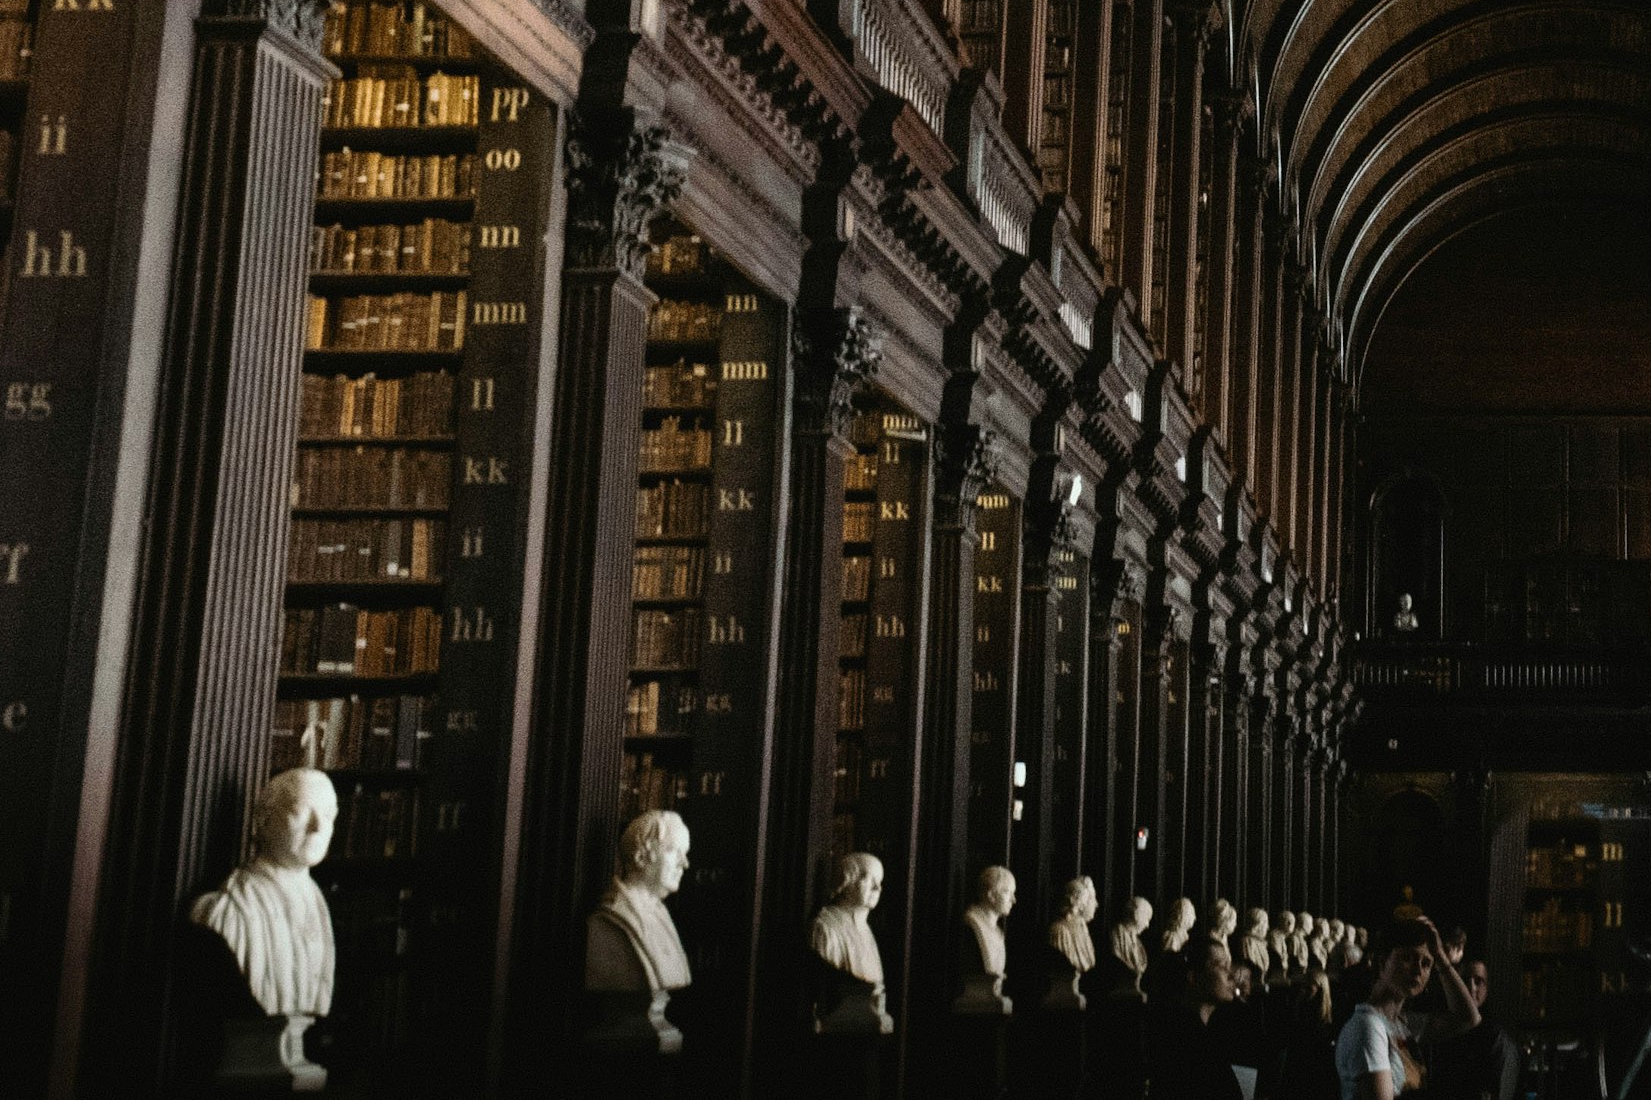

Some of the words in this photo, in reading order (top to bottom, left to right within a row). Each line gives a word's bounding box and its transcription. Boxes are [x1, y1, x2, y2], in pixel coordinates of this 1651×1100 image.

[491, 89, 529, 121] pp
[39, 115, 66, 153] ii
[486, 150, 520, 169] oo
[481, 227, 519, 247] nn
[22, 231, 85, 276] hh
[474, 303, 525, 323] mm
[727, 296, 757, 312] nn
[723, 362, 766, 379] mm
[6, 383, 50, 415] gg
[472, 379, 493, 409] ll
[882, 413, 919, 430] mm
[724, 421, 742, 445] ll
[885, 443, 898, 463] ll
[465, 457, 505, 483] kk
[719, 489, 752, 510] kk
[882, 502, 907, 519] kk
[461, 526, 484, 558] ii
[982, 532, 994, 550] ll
[0, 545, 29, 584] f
[715, 555, 731, 573] ii
[978, 576, 1001, 591] kk
[452, 607, 492, 641] hh
[709, 616, 744, 644] hh
[877, 616, 904, 636] hh
